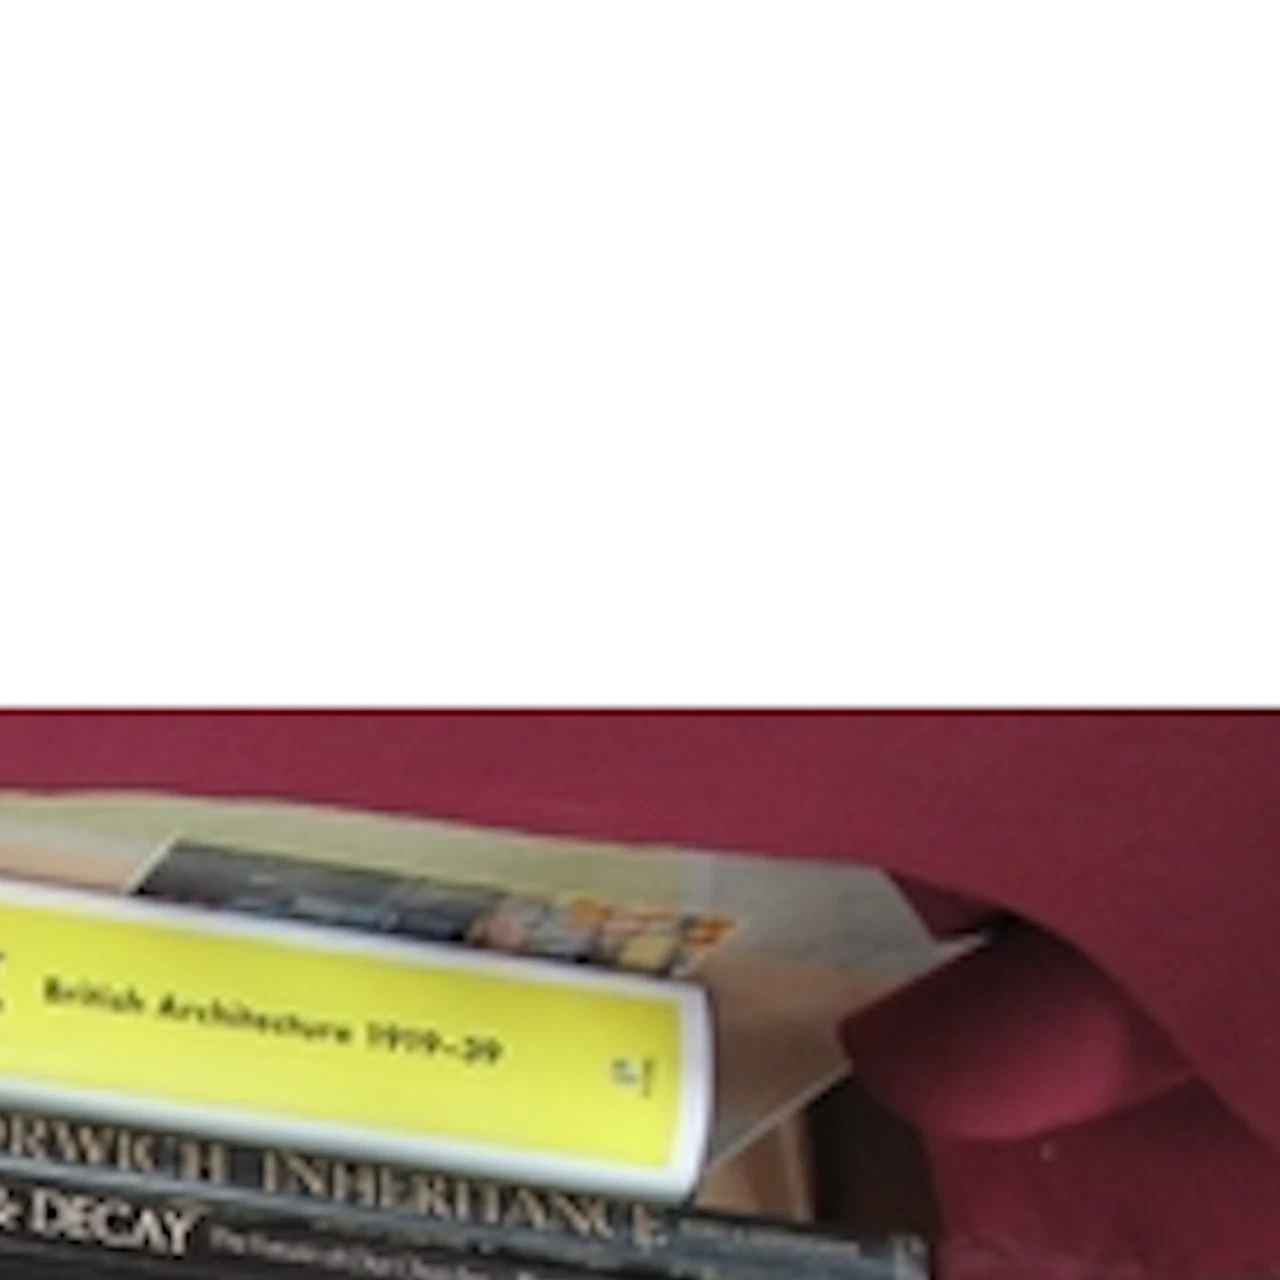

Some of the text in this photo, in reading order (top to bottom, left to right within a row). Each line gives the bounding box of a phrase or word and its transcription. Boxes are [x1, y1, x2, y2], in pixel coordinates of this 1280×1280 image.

[43, 976, 144, 1018] British
[156, 992, 354, 1046] Architecture
[31, 1190, 212, 1258] DECAY
[262, 1148, 667, 1248] INHERITANCE
